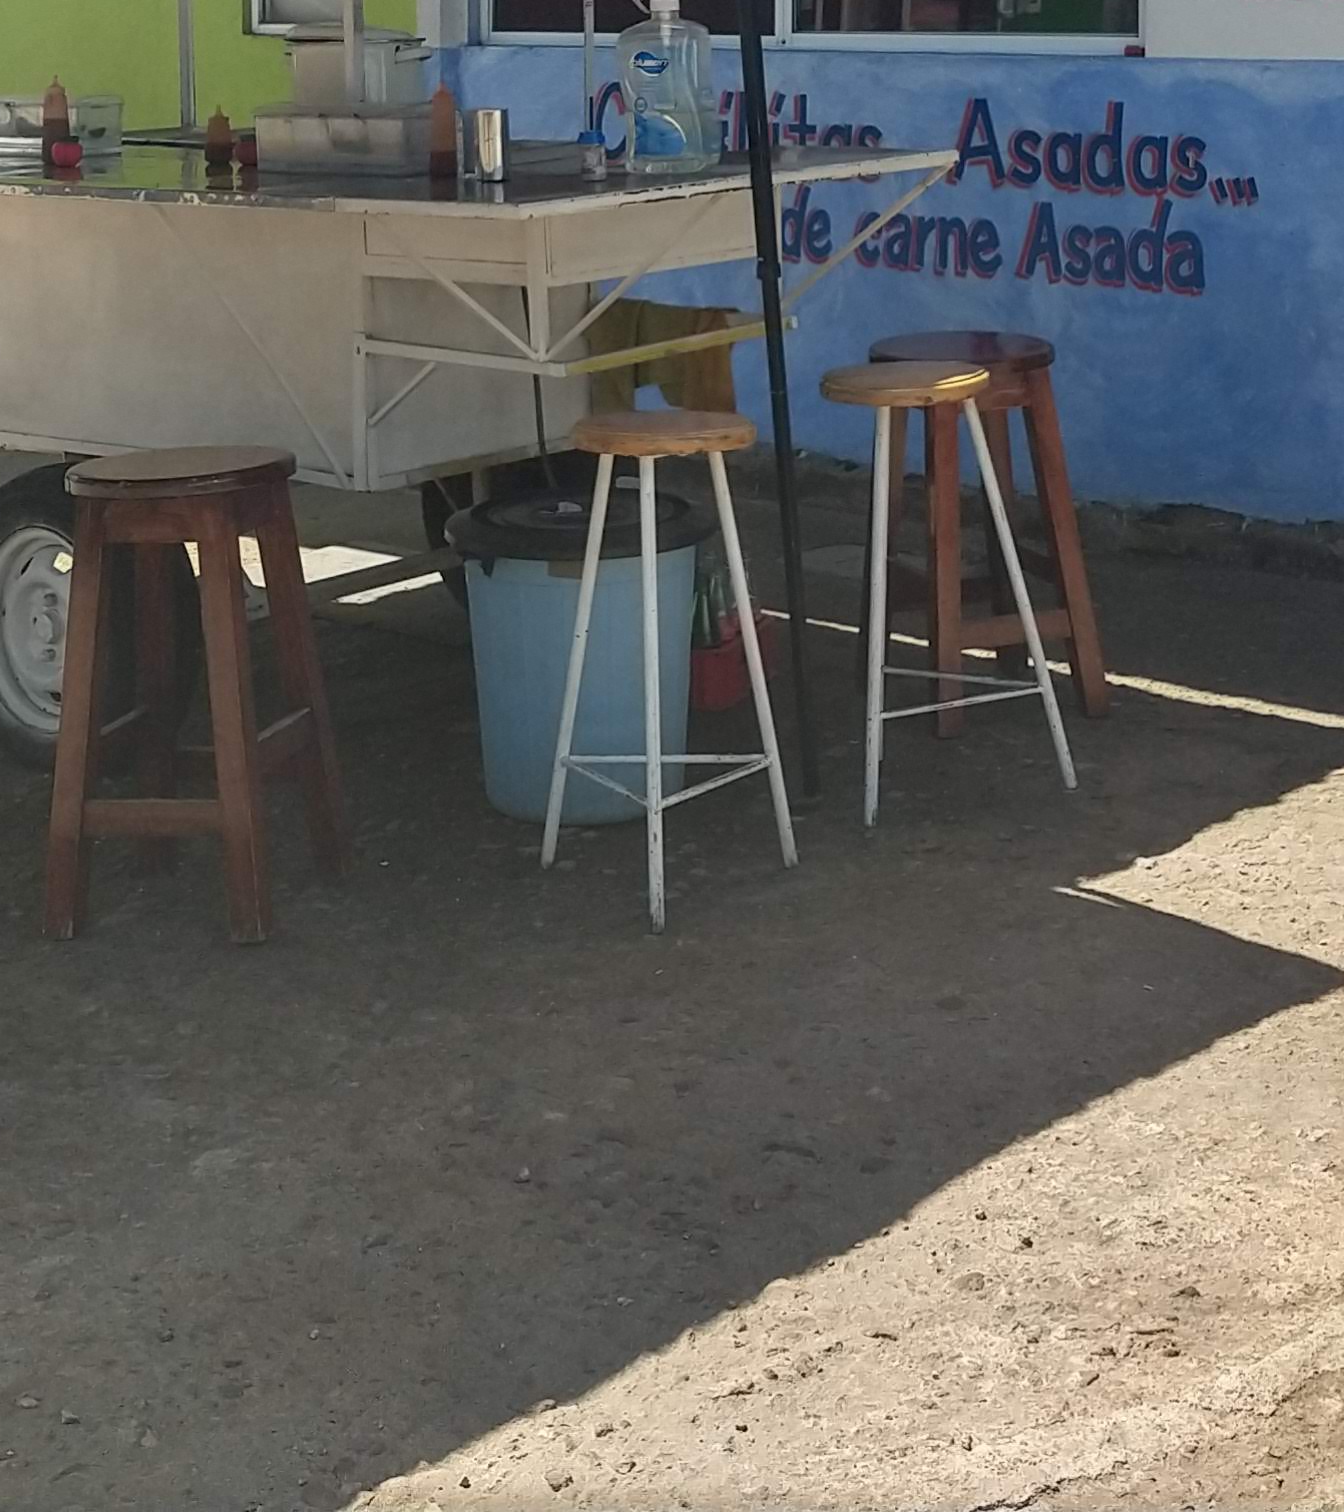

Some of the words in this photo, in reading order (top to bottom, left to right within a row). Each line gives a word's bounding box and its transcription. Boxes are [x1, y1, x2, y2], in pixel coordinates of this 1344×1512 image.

[781, 184, 834, 264] de
[854, 208, 1001, 278] carne
[1015, 193, 1205, 296] Asada
